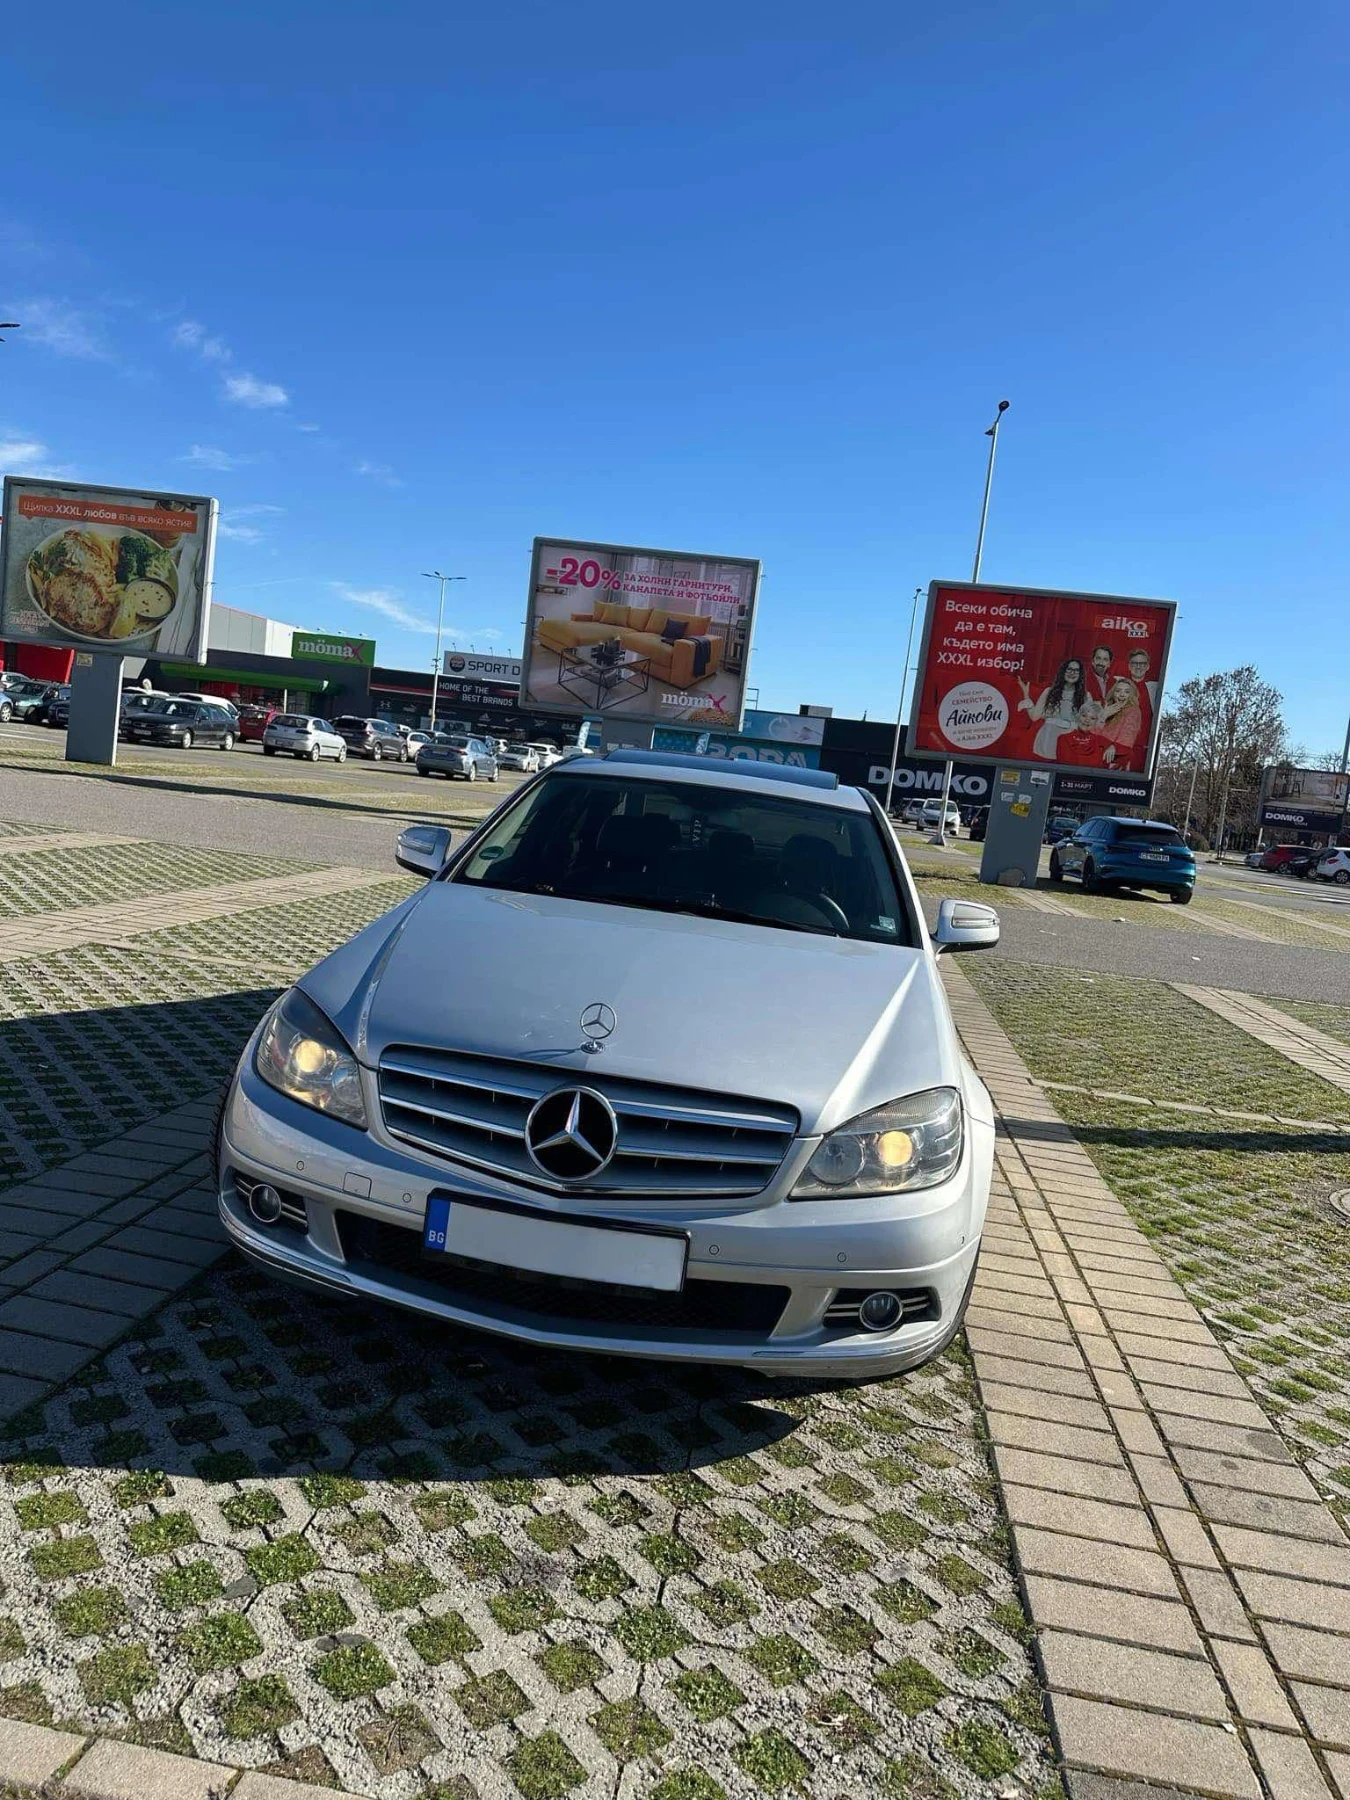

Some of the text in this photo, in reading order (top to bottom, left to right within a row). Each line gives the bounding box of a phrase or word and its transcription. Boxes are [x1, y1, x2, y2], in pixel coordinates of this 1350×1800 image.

[24, 501, 53, 512] Щипка
[56, 504, 81, 515] XXXL
[83, 509, 117, 520] любов
[138, 515, 163, 524] всяко
[166, 519, 192, 527] ястие
[547, 557, 621, 590] -20%
[624, 573, 636, 581] ЗА
[638, 575, 671, 585] ХОЛНИ
[623, 584, 741, 604] КАНАПЕТА И ФОТЬОЙЛИ
[945, 600, 1033, 618] Всеки обича
[955, 621, 1016, 636] да е там,
[1101, 616, 1148, 631] aiko
[943, 637, 1024, 653] където има
[468, 661, 509, 674] SPORT
[937, 651, 1025, 672] XXXL избор!
[438, 682, 460, 692] HOME
[475, 686, 489, 694] THE
[462, 693, 513, 707] BEST BRANDS
[946, 704, 1003, 727] Айкови
[868, 765, 988, 796] DOMKO
[1108, 786, 1146, 797] DOMKO
[1265, 812, 1304, 822] DOMKO
[429, 1230, 444, 1243] BG
